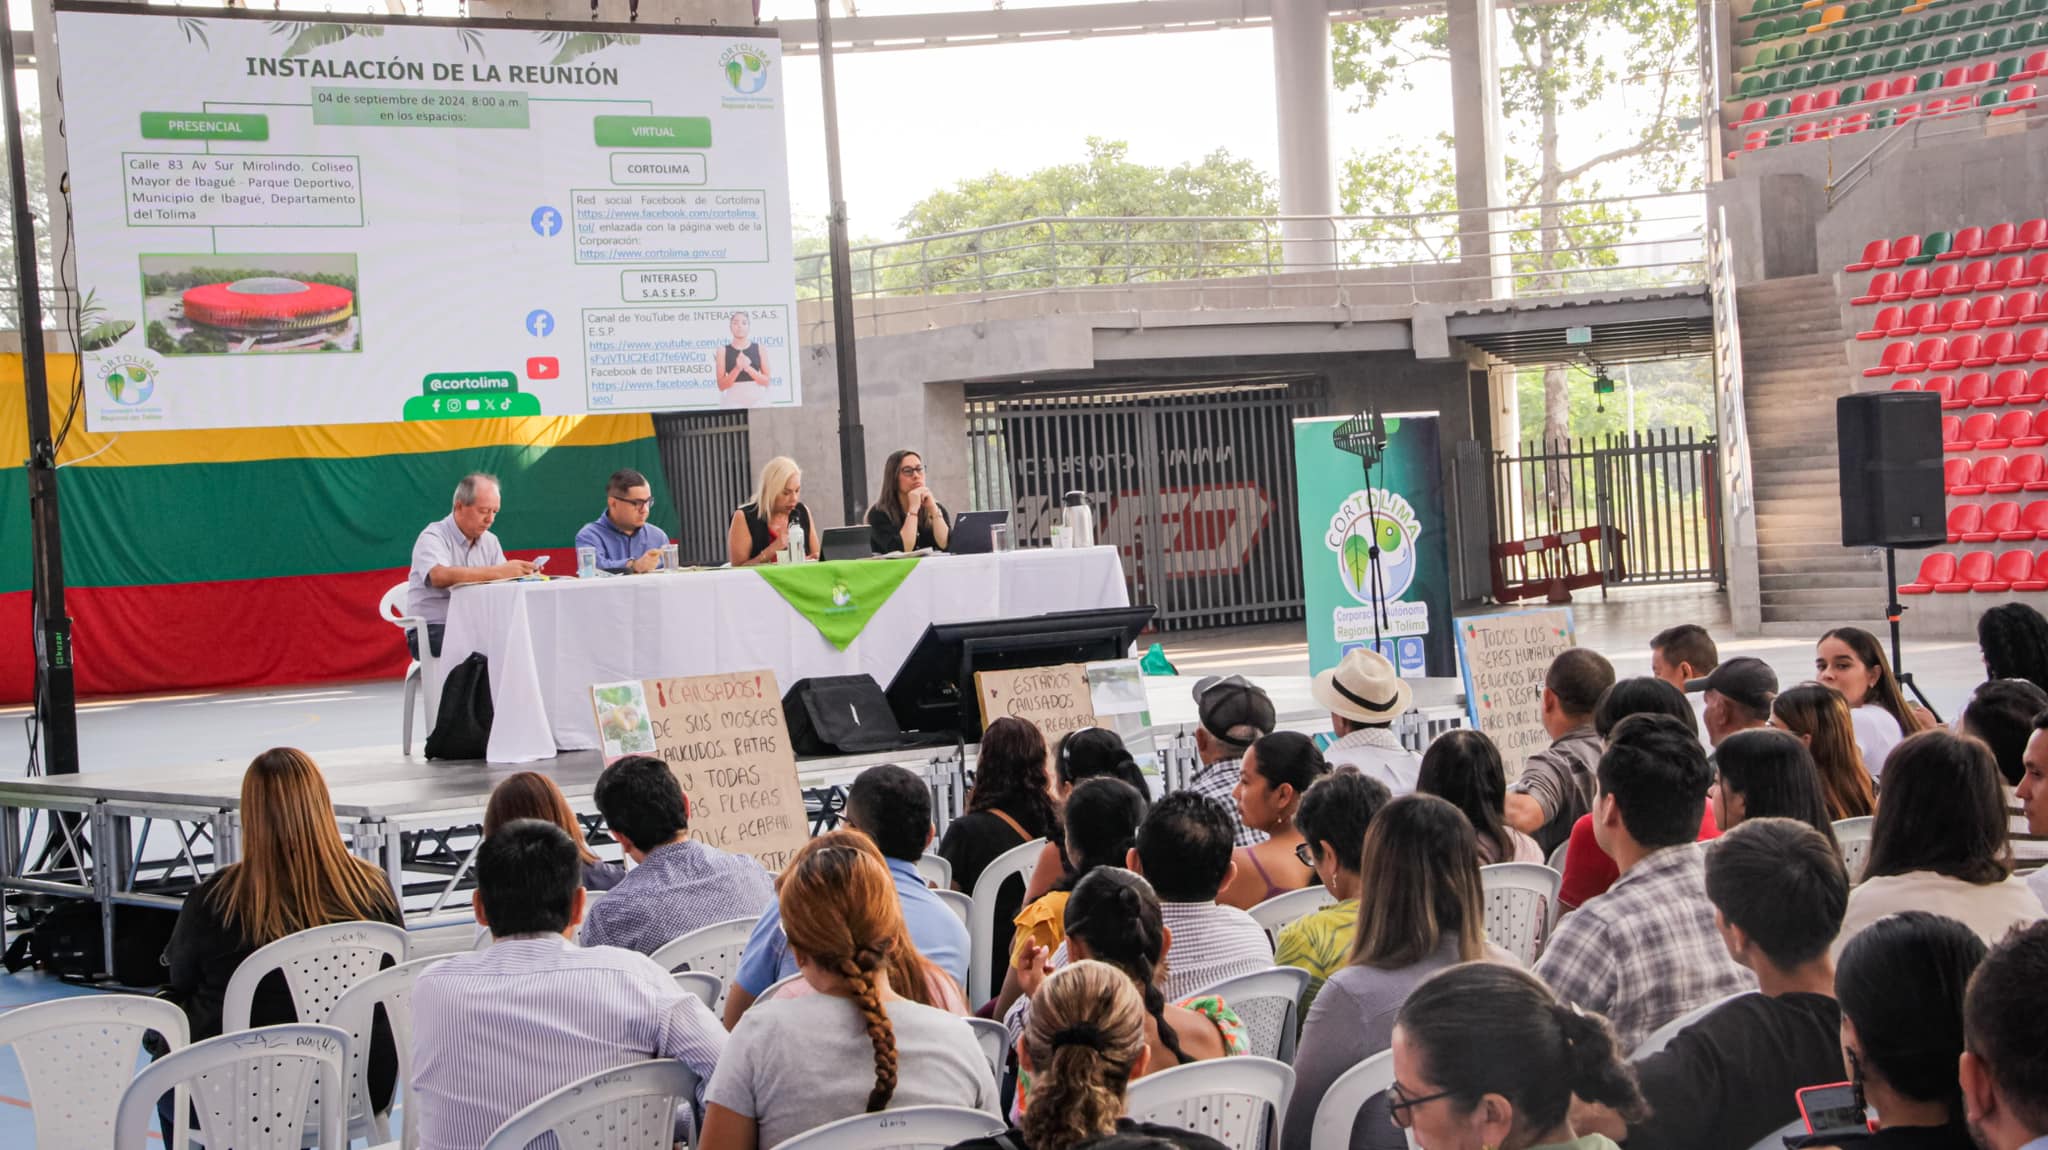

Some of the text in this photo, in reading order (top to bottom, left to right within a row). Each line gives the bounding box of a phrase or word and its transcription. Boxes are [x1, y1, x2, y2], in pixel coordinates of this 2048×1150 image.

[246, 56, 619, 86] INSTALACIÓN DE LA REUNIÓN
[318, 93, 333, 104] 04
[336, 93, 351, 104] de
[354, 94, 417, 107] septiembre
[421, 95, 435, 106] de
[471, 96, 496, 107] 8:00
[380, 110, 467, 124] en los espacios:
[168, 120, 244, 134] PRESENCIAL
[631, 126, 676, 138] VIRTUAL
[129, 159, 160, 171] Calle
[168, 159, 184, 171] 83
[191, 160, 207, 171] Av
[214, 160, 234, 171] Sur
[311, 161, 354, 173] Coliseo
[627, 163, 690, 175] CORTOLIMA
[131, 176, 171, 189] Mayor
[175, 176, 191, 187] de
[195, 176, 236, 189] Ibagué
[248, 177, 290, 190] Parque
[293, 178, 355, 190] Deportivo,
[132, 192, 195, 206] Municipio
[200, 192, 216, 204] de
[271, 193, 357, 206] Departamento
[576, 195, 761, 206] Red social Facebook de Cortolima
[133, 208, 197, 221] del Tolima
[599, 222, 643, 233] enlazada
[646, 223, 664, 233] con
[667, 222, 677, 233] la
[679, 222, 713, 235] página
[715, 222, 736, 233] web
[738, 222, 751, 233] de
[753, 222, 763, 233] la
[578, 236, 642, 248] Corporación:
[639, 273, 699, 284] INTERASEO
[587, 313, 616, 324] Canal
[618, 312, 632, 323] de
[634, 311, 676, 323] YouTube
[678, 311, 691, 322] de
[588, 327, 616, 338] E.S.P.
[591, 364, 713, 377] Facebook de INTERASEO
[430, 376, 510, 392] @cortolima
[1328, 492, 1419, 548] CORTOLIMA
[1395, 620, 1426, 632] Tolima
[1477, 626, 1546, 649] TODOS LOS
[1013, 672, 1071, 696] ESTAMOS
[1006, 693, 1074, 718] CANSADOS
[652, 706, 779, 740] DE SUS MOSCAS
[734, 735, 777, 757] RATAS
[703, 764, 761, 788] TODAS
[689, 787, 780, 820] AS PLAGAS
